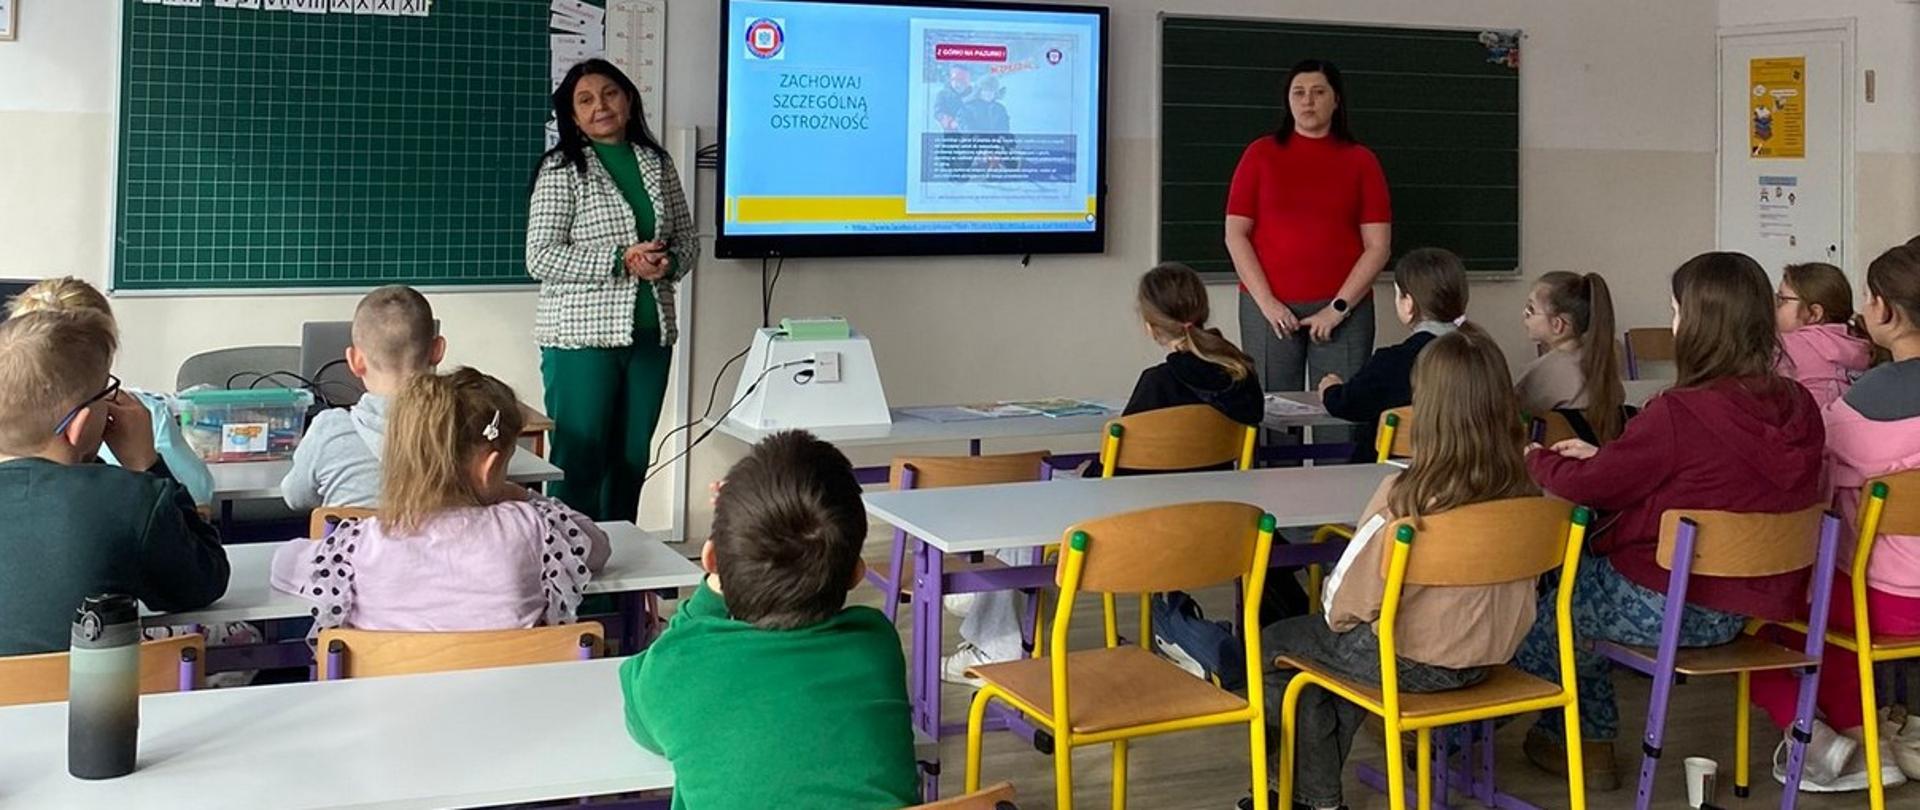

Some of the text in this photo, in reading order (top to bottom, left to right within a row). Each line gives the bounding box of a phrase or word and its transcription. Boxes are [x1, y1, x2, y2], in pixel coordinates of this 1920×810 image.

[780, 74, 861, 89] ZACHOWAJ
[773, 92, 867, 112] SZCZEGÓLNĄ
[770, 112, 869, 130] OSTROŻNOŚĆ
